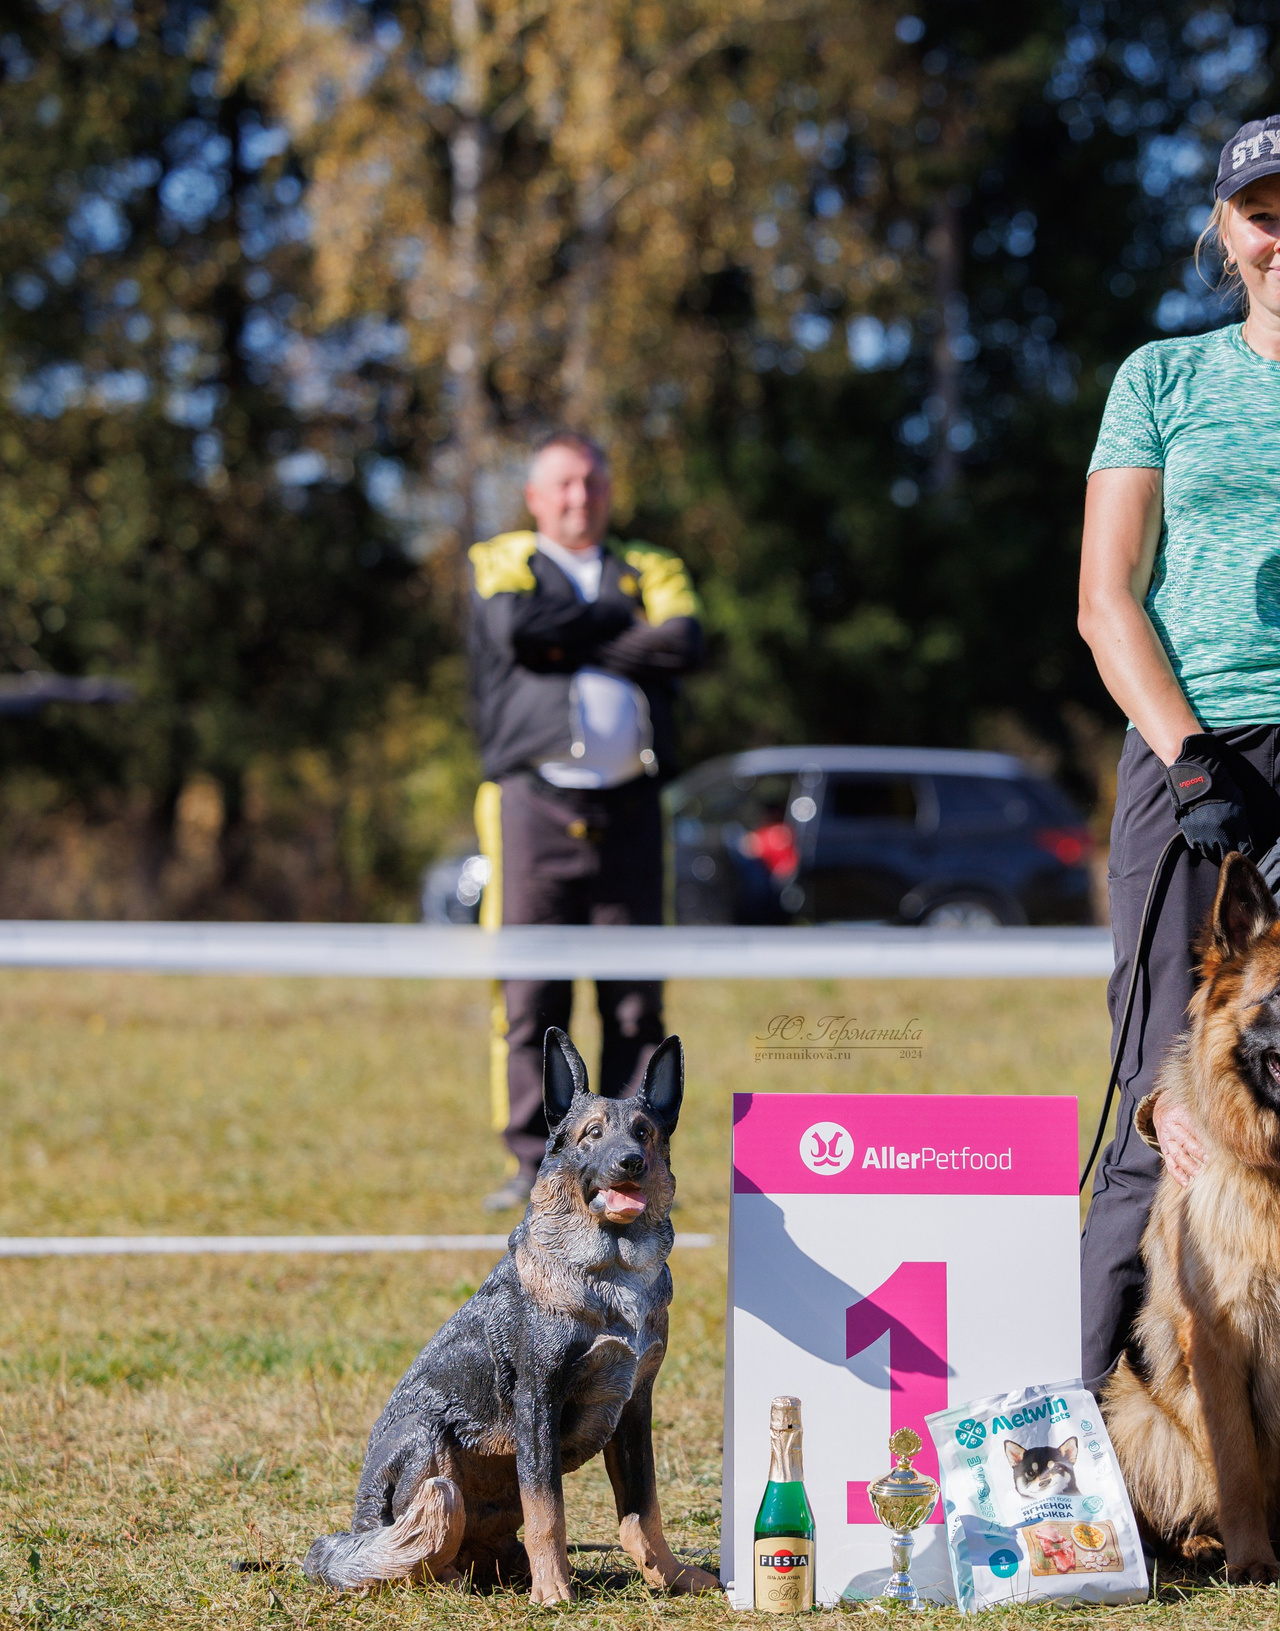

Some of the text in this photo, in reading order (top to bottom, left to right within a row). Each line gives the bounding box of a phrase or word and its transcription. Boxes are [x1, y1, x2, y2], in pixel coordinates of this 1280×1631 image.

[861, 1146, 1013, 1170] AllerPetfood
[846, 1261, 949, 1525] 1
[1049, 1412, 1071, 1425] cats
[1022, 1502, 1073, 1516] ЯГНЕНОК
[1034, 1511, 1074, 1519] ТЫКВА
[761, 1556, 807, 1567] FIESTA
[998, 1556, 1010, 1565] 1
